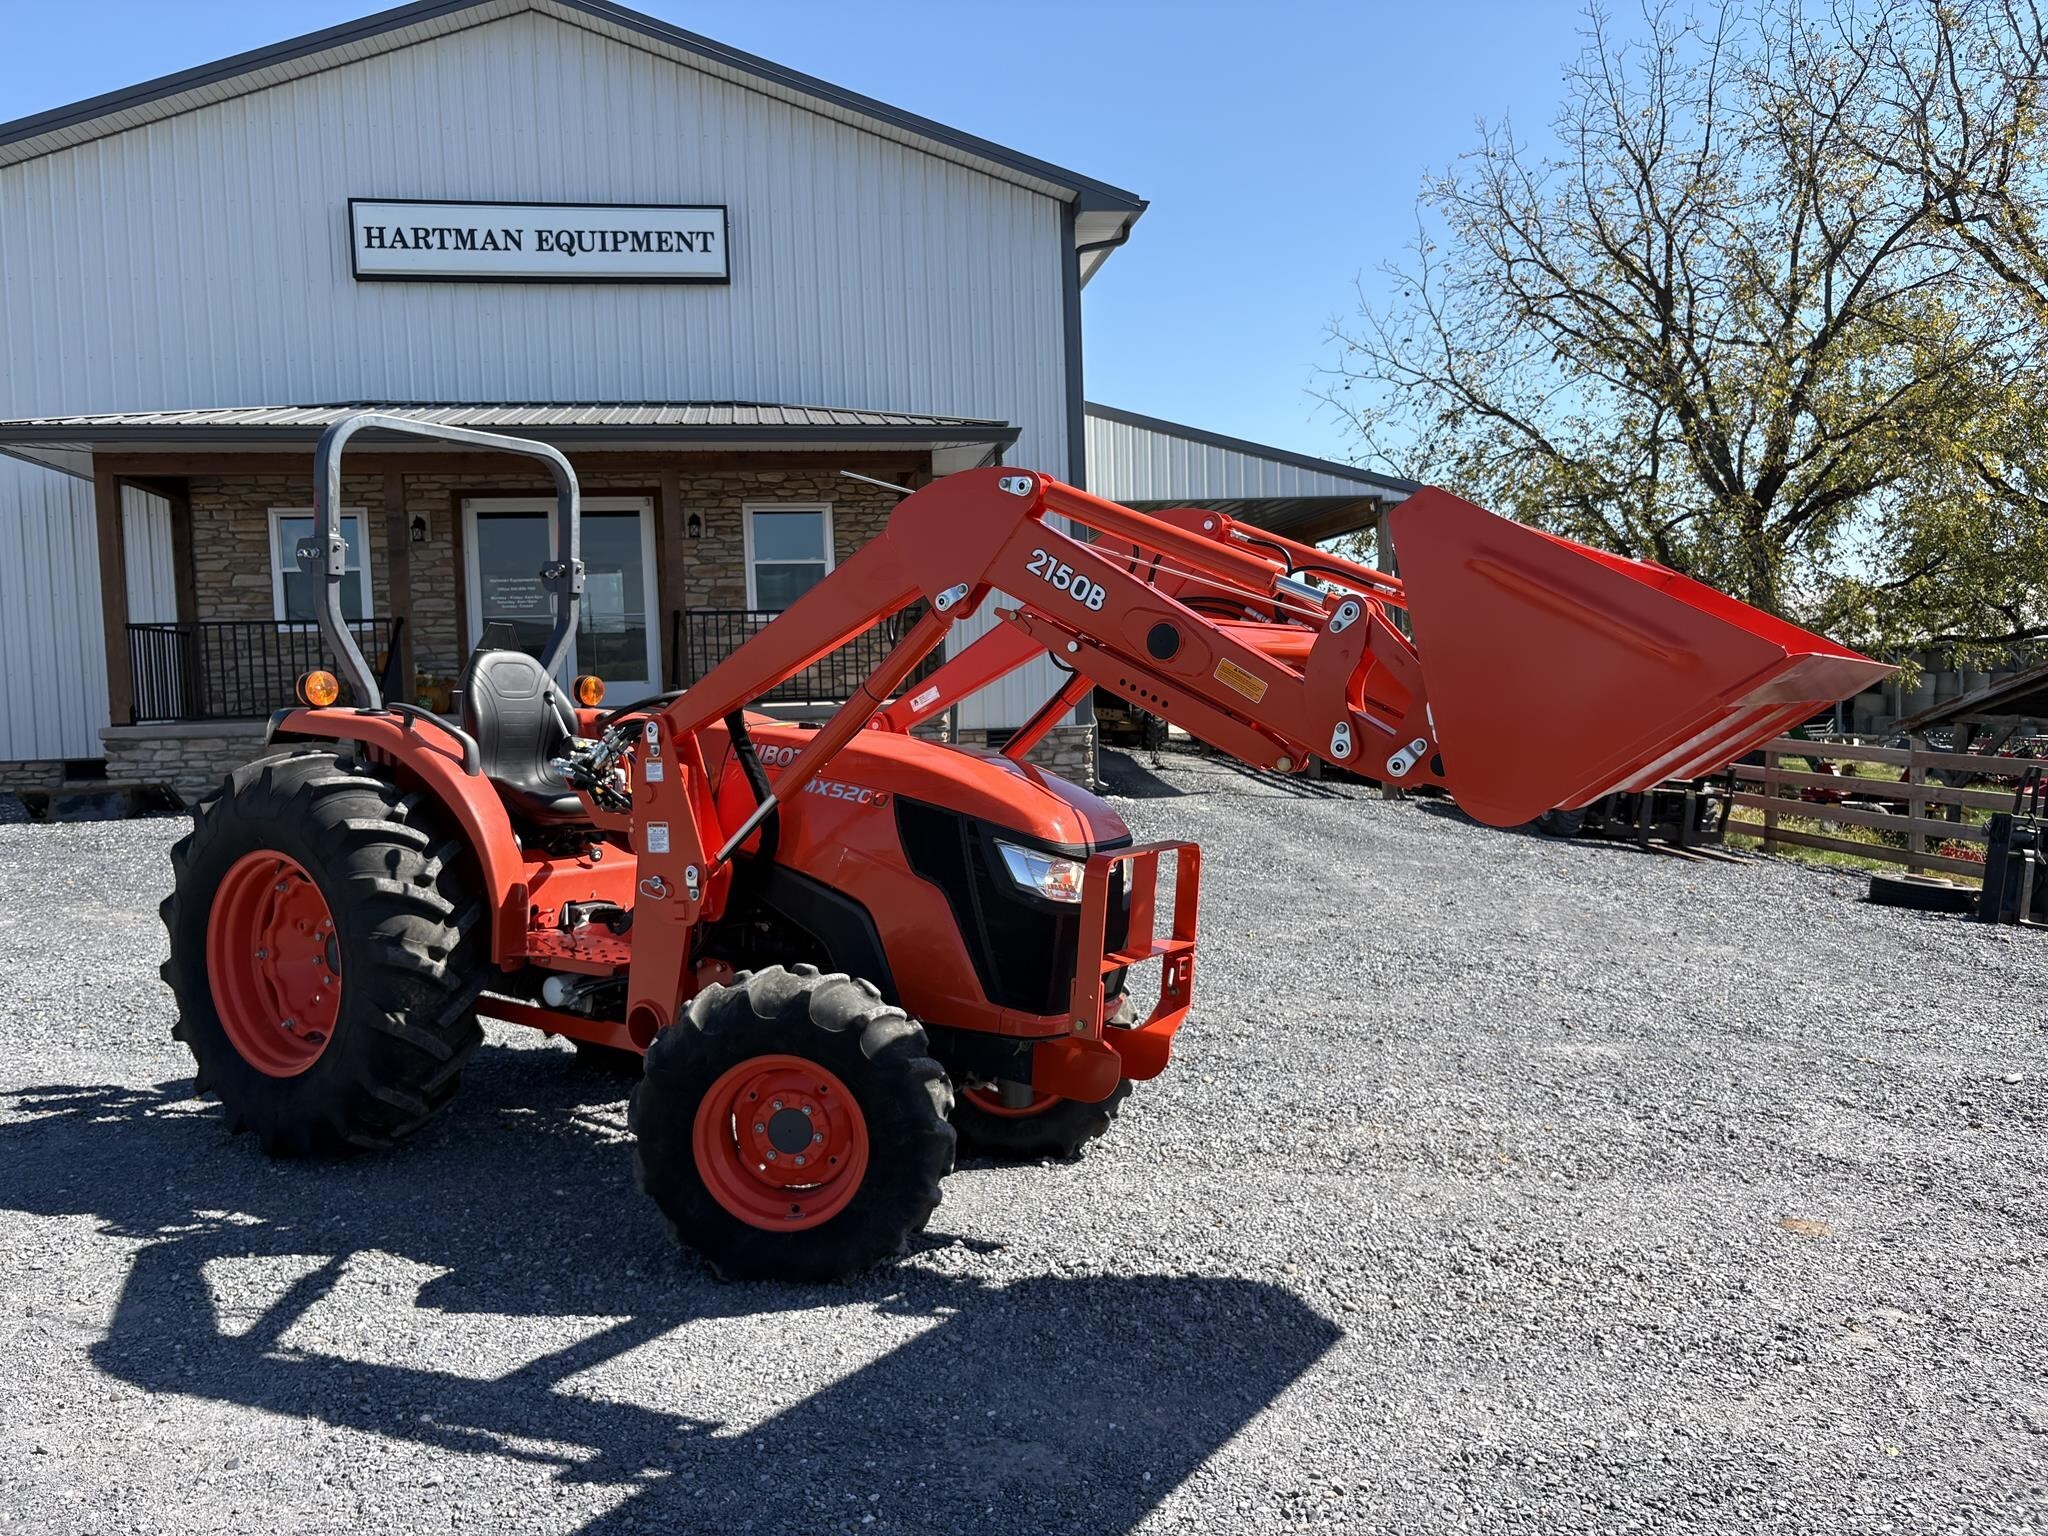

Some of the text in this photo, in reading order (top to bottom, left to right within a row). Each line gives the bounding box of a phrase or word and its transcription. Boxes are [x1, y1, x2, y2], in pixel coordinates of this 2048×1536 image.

[364, 226, 714, 257] HARTMAN EQUIPMENT
[1025, 548, 1107, 611] 2150B
